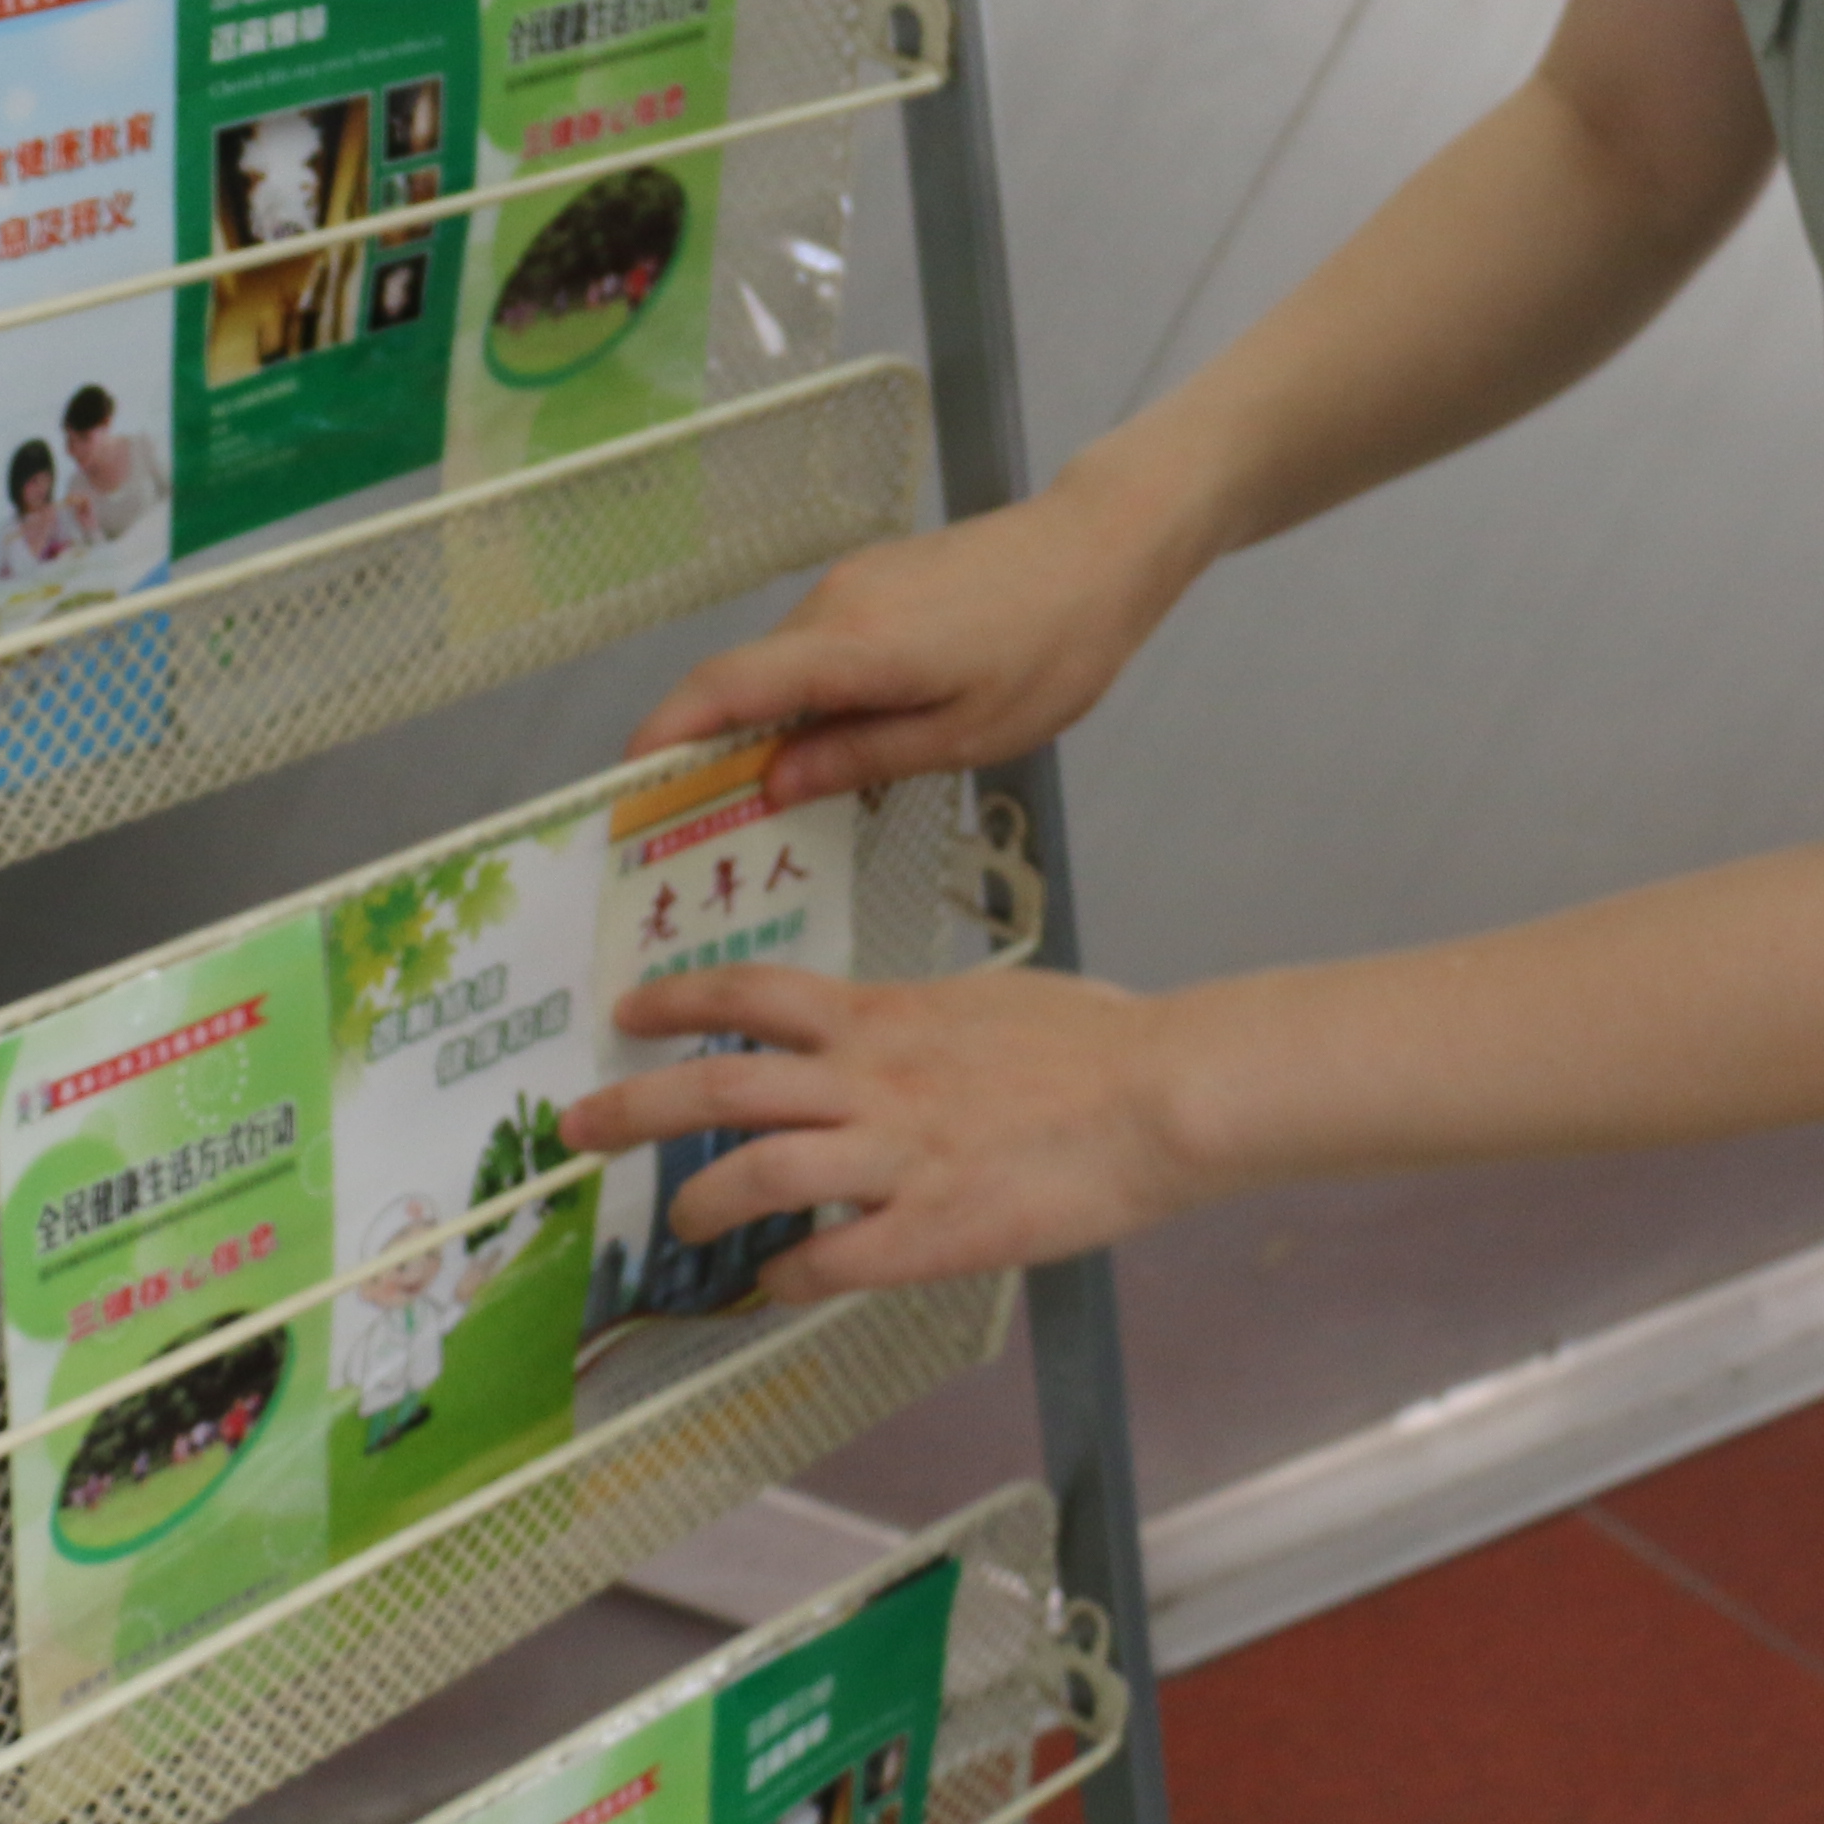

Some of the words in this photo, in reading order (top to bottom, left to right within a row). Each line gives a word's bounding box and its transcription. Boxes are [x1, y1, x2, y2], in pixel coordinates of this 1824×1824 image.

[639, 843, 809, 952] 老年人
[37, 1101, 294, 1256] 全民健康生活方式行动
